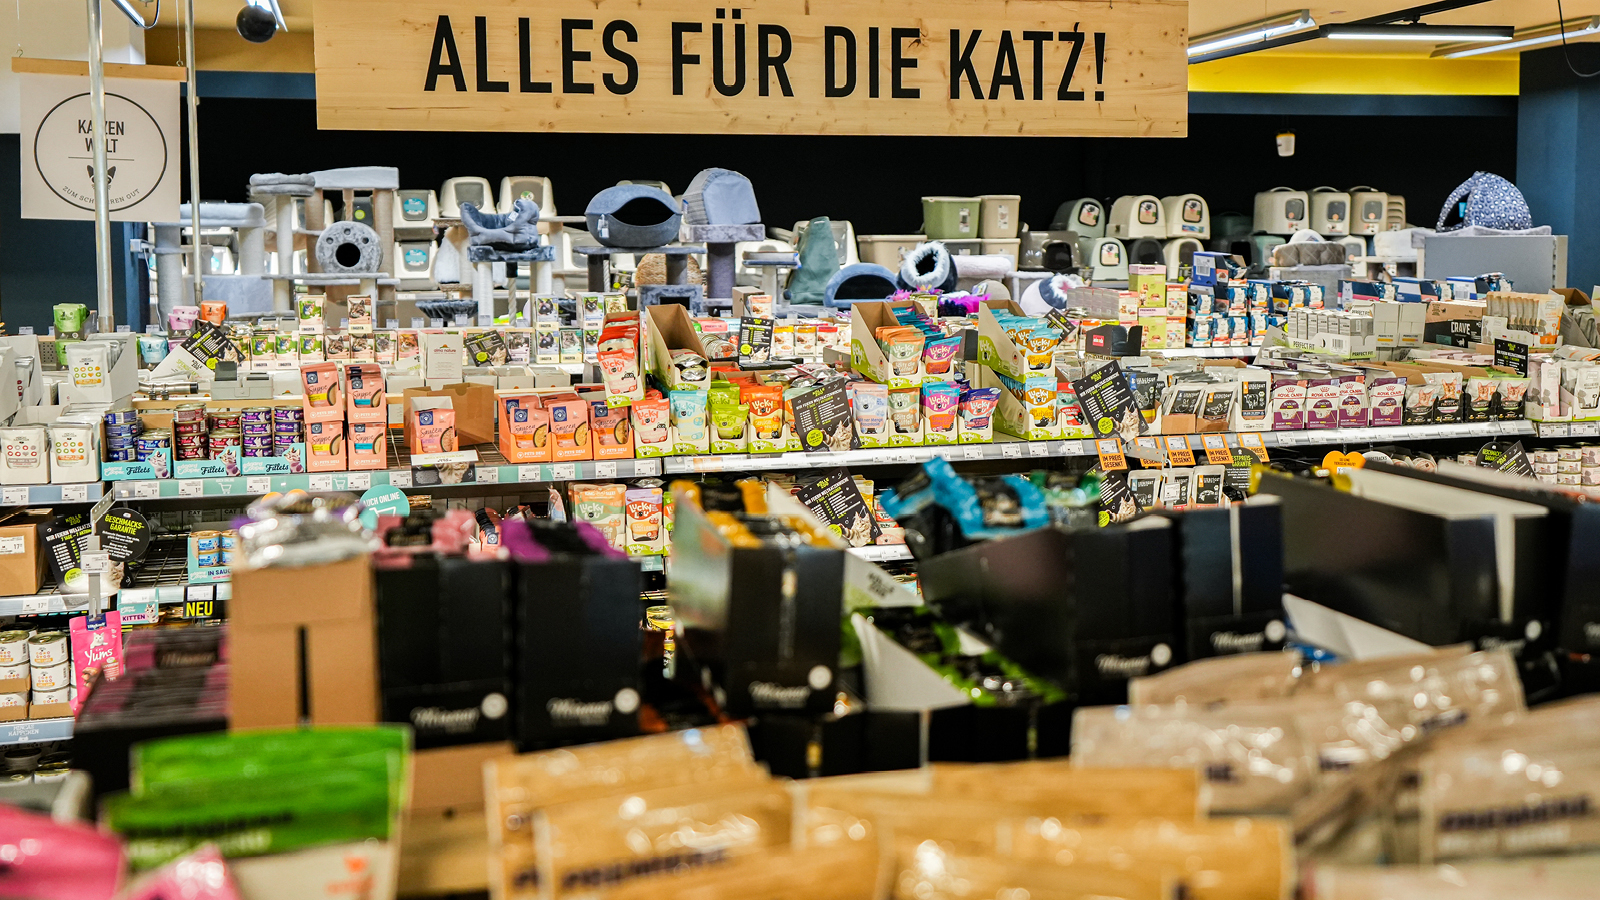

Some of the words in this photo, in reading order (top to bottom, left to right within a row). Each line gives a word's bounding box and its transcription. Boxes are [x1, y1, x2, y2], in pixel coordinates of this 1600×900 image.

[424, 15, 639, 95] ALLES
[671, 8, 794, 97] FÜR
[824, 26, 921, 99] DIE
[950, 29, 1106, 101] KATZ!
[78, 119, 124, 135] KAZEN
[85, 138, 118, 153] WLT
[62, 186, 78, 198] ZUM
[126, 188, 141, 200] GUT
[1450, 321, 1471, 336] CRAVE
[893, 344, 915, 353] Lucky
[1030, 338, 1051, 348] Lucky
[1293, 341, 1309, 349] PERFECT
[930, 346, 951, 355] Lucky
[602, 359, 625, 370] Lucky
[1027, 387, 1049, 398] Lucky
[751, 398, 774, 410] Lucky
[928, 395, 950, 406] Lucky
[970, 401, 991, 410] Lucky
[637, 410, 659, 420] Lucky
[126, 466, 150, 477] Fillets
[200, 466, 225, 475] Fillets
[265, 463, 289, 472] Fillets
[379, 491, 400, 504] ONLINE
[579, 503, 605, 513] Lucky
[628, 502, 652, 512] Lucky
[104, 514, 145, 529] GESCHMACKS-
[109, 523, 137, 535] GARANTIE
[186, 601, 213, 617] NEU
[122, 614, 146, 622] KITTEN
[84, 648, 113, 666] Yums
